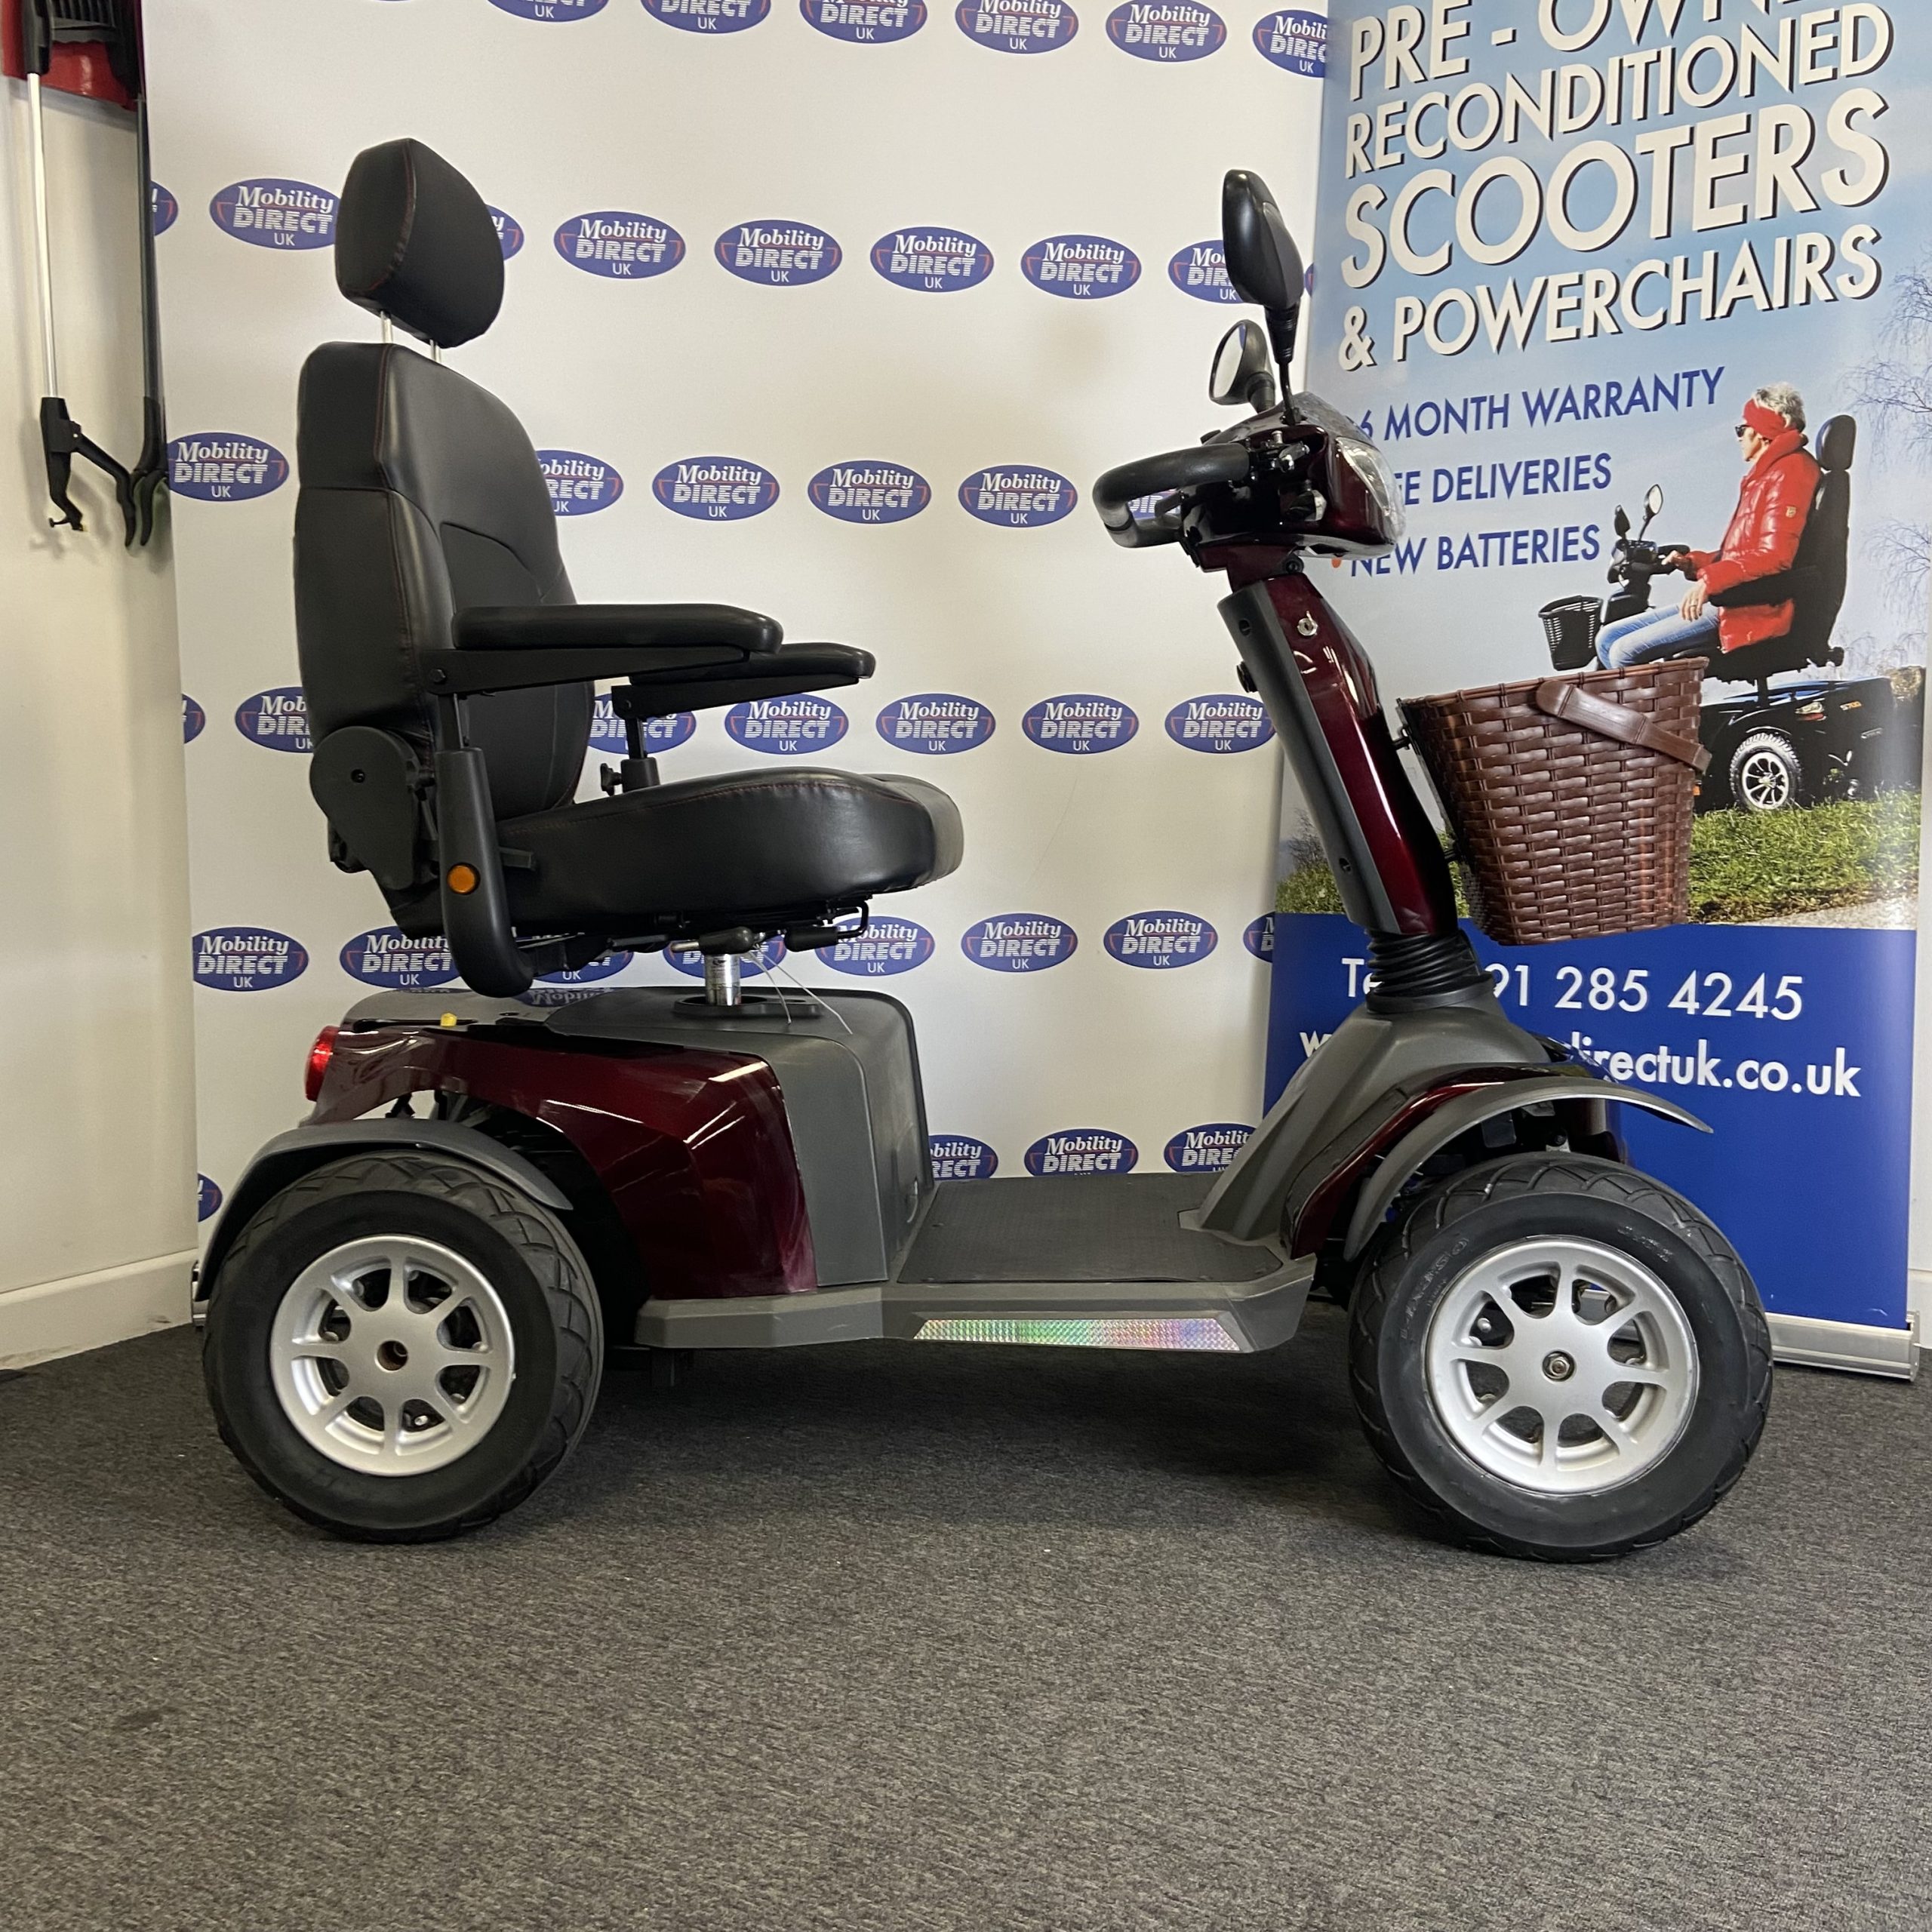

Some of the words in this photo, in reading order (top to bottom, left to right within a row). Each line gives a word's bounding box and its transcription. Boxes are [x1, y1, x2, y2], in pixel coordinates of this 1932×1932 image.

[535, 5, 554, 18] UK
[820, 4, 909, 27] DIRECT
[977, 0, 1061, 19] Mobility
[1128, 4, 1211, 27] Mobility
[697, 17, 717, 29] UK
[975, 14, 1060, 38] DIRECT
[1273, 15, 1327, 38] Mobili
[856, 27, 875, 40] UK
[1125, 24, 1209, 46] DIRECT
[1010, 38, 1027, 50] UK
[1159, 46, 1177, 58] UK
[1270, 35, 1327, 63] DIREC
[1350, 0, 1472, 100] PRE
[1300, 60, 1314, 73] UK
[1346, 3, 1894, 178] RECONDITIONED
[1341, 88, 1888, 289] SCOOTERS
[235, 186, 334, 214] Mobility
[233, 207, 333, 234] DIRECT
[274, 232, 295, 246] UK
[577, 219, 666, 243] Mobility
[737, 227, 824, 254] Mobility
[575, 238, 666, 263] DIRECT
[892, 235, 977, 257] Mobility
[1042, 242, 1124, 264] Mobility
[735, 248, 823, 269] DIRECT
[891, 254, 976, 276] DIRECT
[612, 263, 631, 275] UK
[771, 270, 789, 282] UK
[1040, 262, 1123, 283] DIRECT
[924, 277, 943, 289] UK
[1073, 284, 1091, 296] UK
[1220, 289, 1236, 300] UK
[1339, 306, 1376, 371] &
[1393, 225, 1882, 361] POWERCHAIRS
[1384, 393, 1509, 441] MONTH
[1522, 367, 1725, 427] WARRANTY
[175, 441, 269, 463] Mobility
[174, 463, 268, 484] DIRECT
[538, 458, 605, 481] obility
[675, 465, 761, 485] Mobility
[829, 469, 914, 489] Mobility
[1432, 453, 1612, 503] DELIVERIES
[211, 485, 231, 497] UK
[545, 478, 604, 500] RECT
[980, 472, 1061, 493] Mobility
[673, 484, 761, 504] DIRECT
[828, 488, 913, 507] DIRECT
[977, 492, 1060, 511] DIRECT
[709, 506, 727, 517] UK
[863, 509, 880, 521] UK
[1011, 513, 1028, 524] UK
[1437, 524, 1601, 571] BATTERIES
[746, 701, 831, 720] Mobility
[897, 702, 979, 720] Mobility
[1043, 703, 1122, 724] Mobility
[1185, 703, 1263, 720] Mobility
[257, 715, 310, 735] DIR
[745, 720, 830, 738] DIRECT
[895, 721, 978, 738] DIRECT
[1041, 721, 1121, 738] DIRECT
[1183, 721, 1262, 738] DIRECT
[780, 740, 797, 751] UK
[929, 740, 946, 751] UK
[1073, 740, 1090, 751] UK
[1215, 740, 1232, 750] UK
[981, 921, 1061, 940] Mobility
[1124, 918, 1202, 937] Mobility
[198, 936, 289, 955] Mobility
[364, 934, 450, 953] Mobilit
[834, 942, 917, 961] DIRECT
[980, 939, 1060, 958] DIRECT
[1121, 936, 1201, 954] DIRECT
[197, 955, 288, 974] DIRECT
[362, 953, 452, 972] DIRECT
[867, 962, 885, 973] UK
[1012, 958, 1029, 969] UK
[1153, 955, 1170, 966] UK
[233, 977, 253, 988] UK
[400, 974, 420, 986] UK
[561, 971, 581, 980] UK
[1555, 966, 1648, 1012] 285
[1668, 970, 1804, 1021] 4245
[1044, 1136, 1122, 1155] Mobility
[1185, 1131, 1253, 1149] Mobilit
[931, 1159, 980, 1177] RECT
[1043, 1152, 1121, 1173] DIRECT
